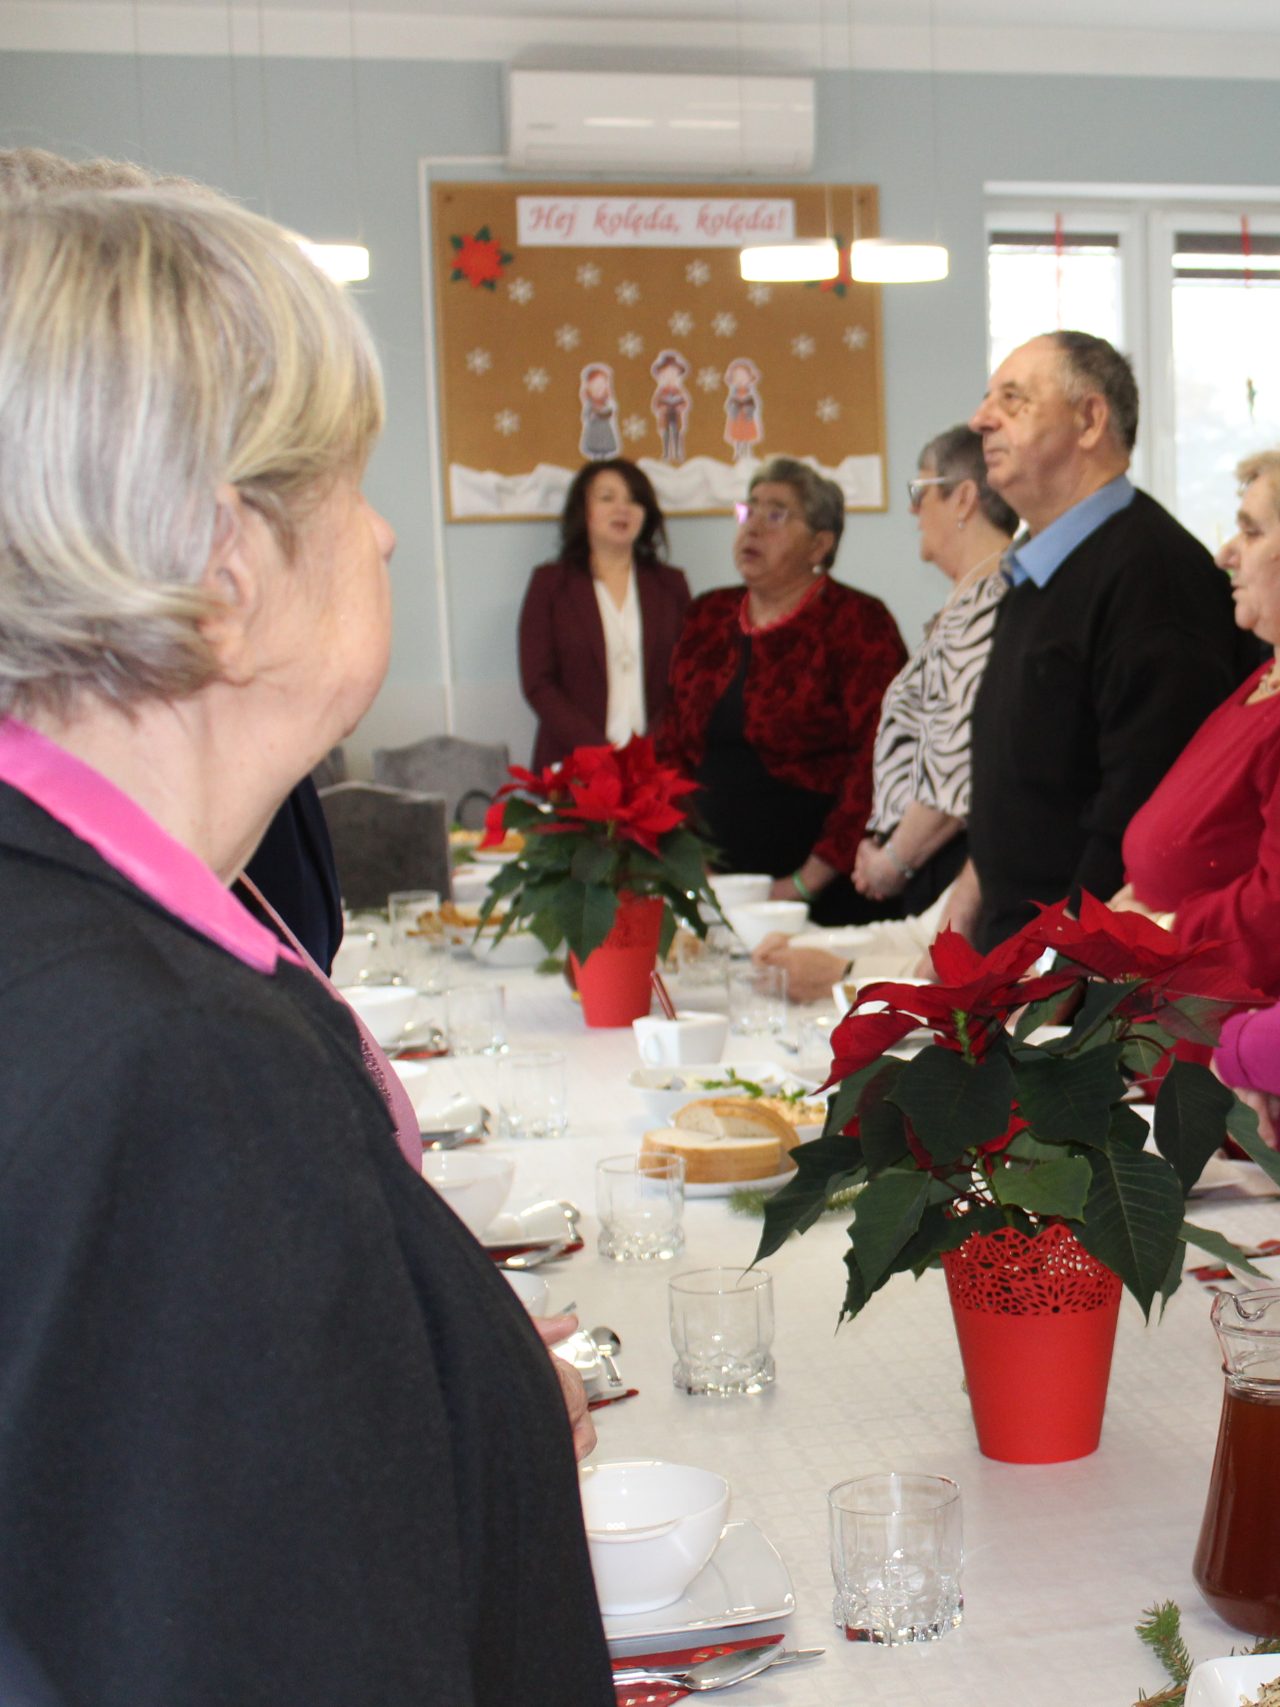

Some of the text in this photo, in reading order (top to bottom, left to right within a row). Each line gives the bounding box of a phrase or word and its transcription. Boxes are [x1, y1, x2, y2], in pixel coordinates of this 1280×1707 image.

[528, 202, 787, 238] Hej kolęda, kolęda!
